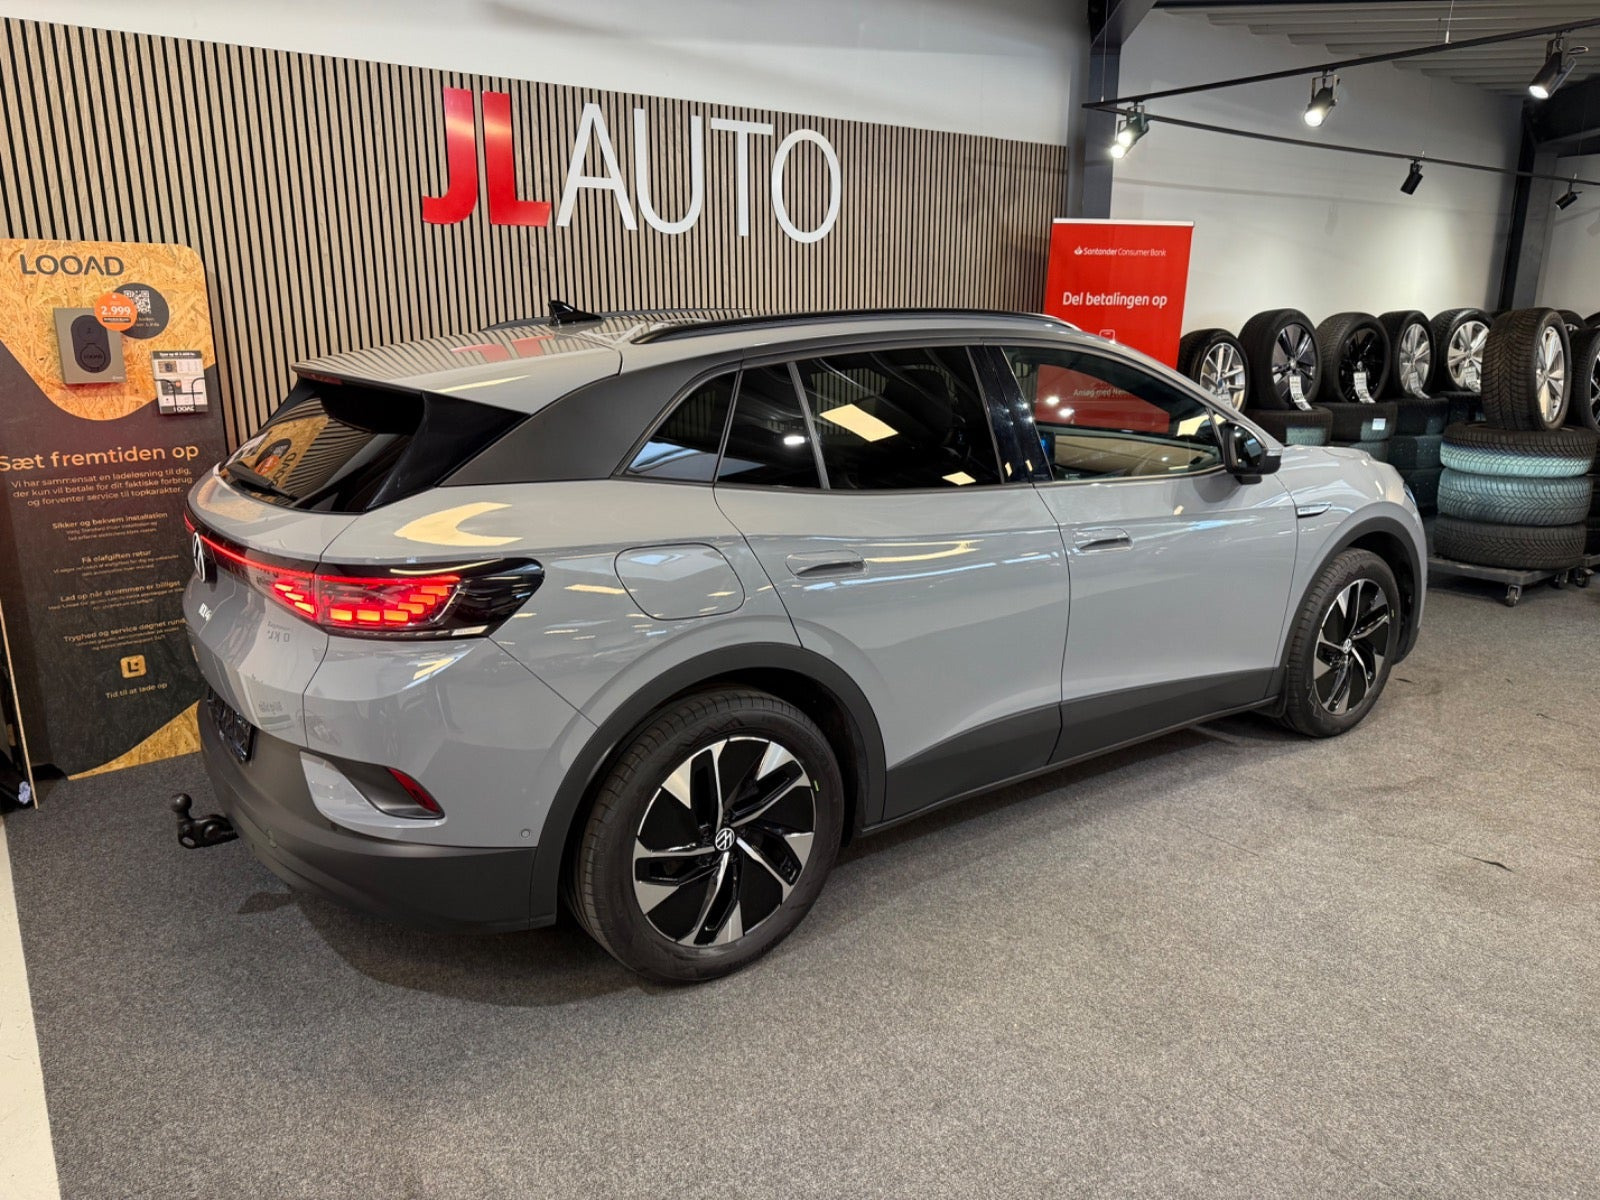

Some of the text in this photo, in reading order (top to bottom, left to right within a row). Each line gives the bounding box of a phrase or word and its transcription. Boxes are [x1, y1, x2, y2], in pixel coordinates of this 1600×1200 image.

[1083, 247, 1167, 257] Santander Consumer Bank
[20, 254, 125, 276] LOOAD
[1062, 292, 1168, 309] Del betalingen op
[0, 445, 199, 471] Sæt fremtiden op
[11, 480, 21, 489] Vi
[24, 479, 40, 487] har
[42, 475, 97, 486] sammensat
[112, 469, 163, 479] ladeløsning
[165, 468, 174, 476] til
[12, 489, 29, 498] der
[32, 489, 50, 497] kun
[52, 487, 64, 495] vil
[65, 484, 94, 493] betale
[96, 483, 109, 491] for
[125, 479, 159, 489] faktiske
[160, 476, 193, 486] forbrug
[27, 499, 40, 507] og
[86, 492, 119, 501] service
